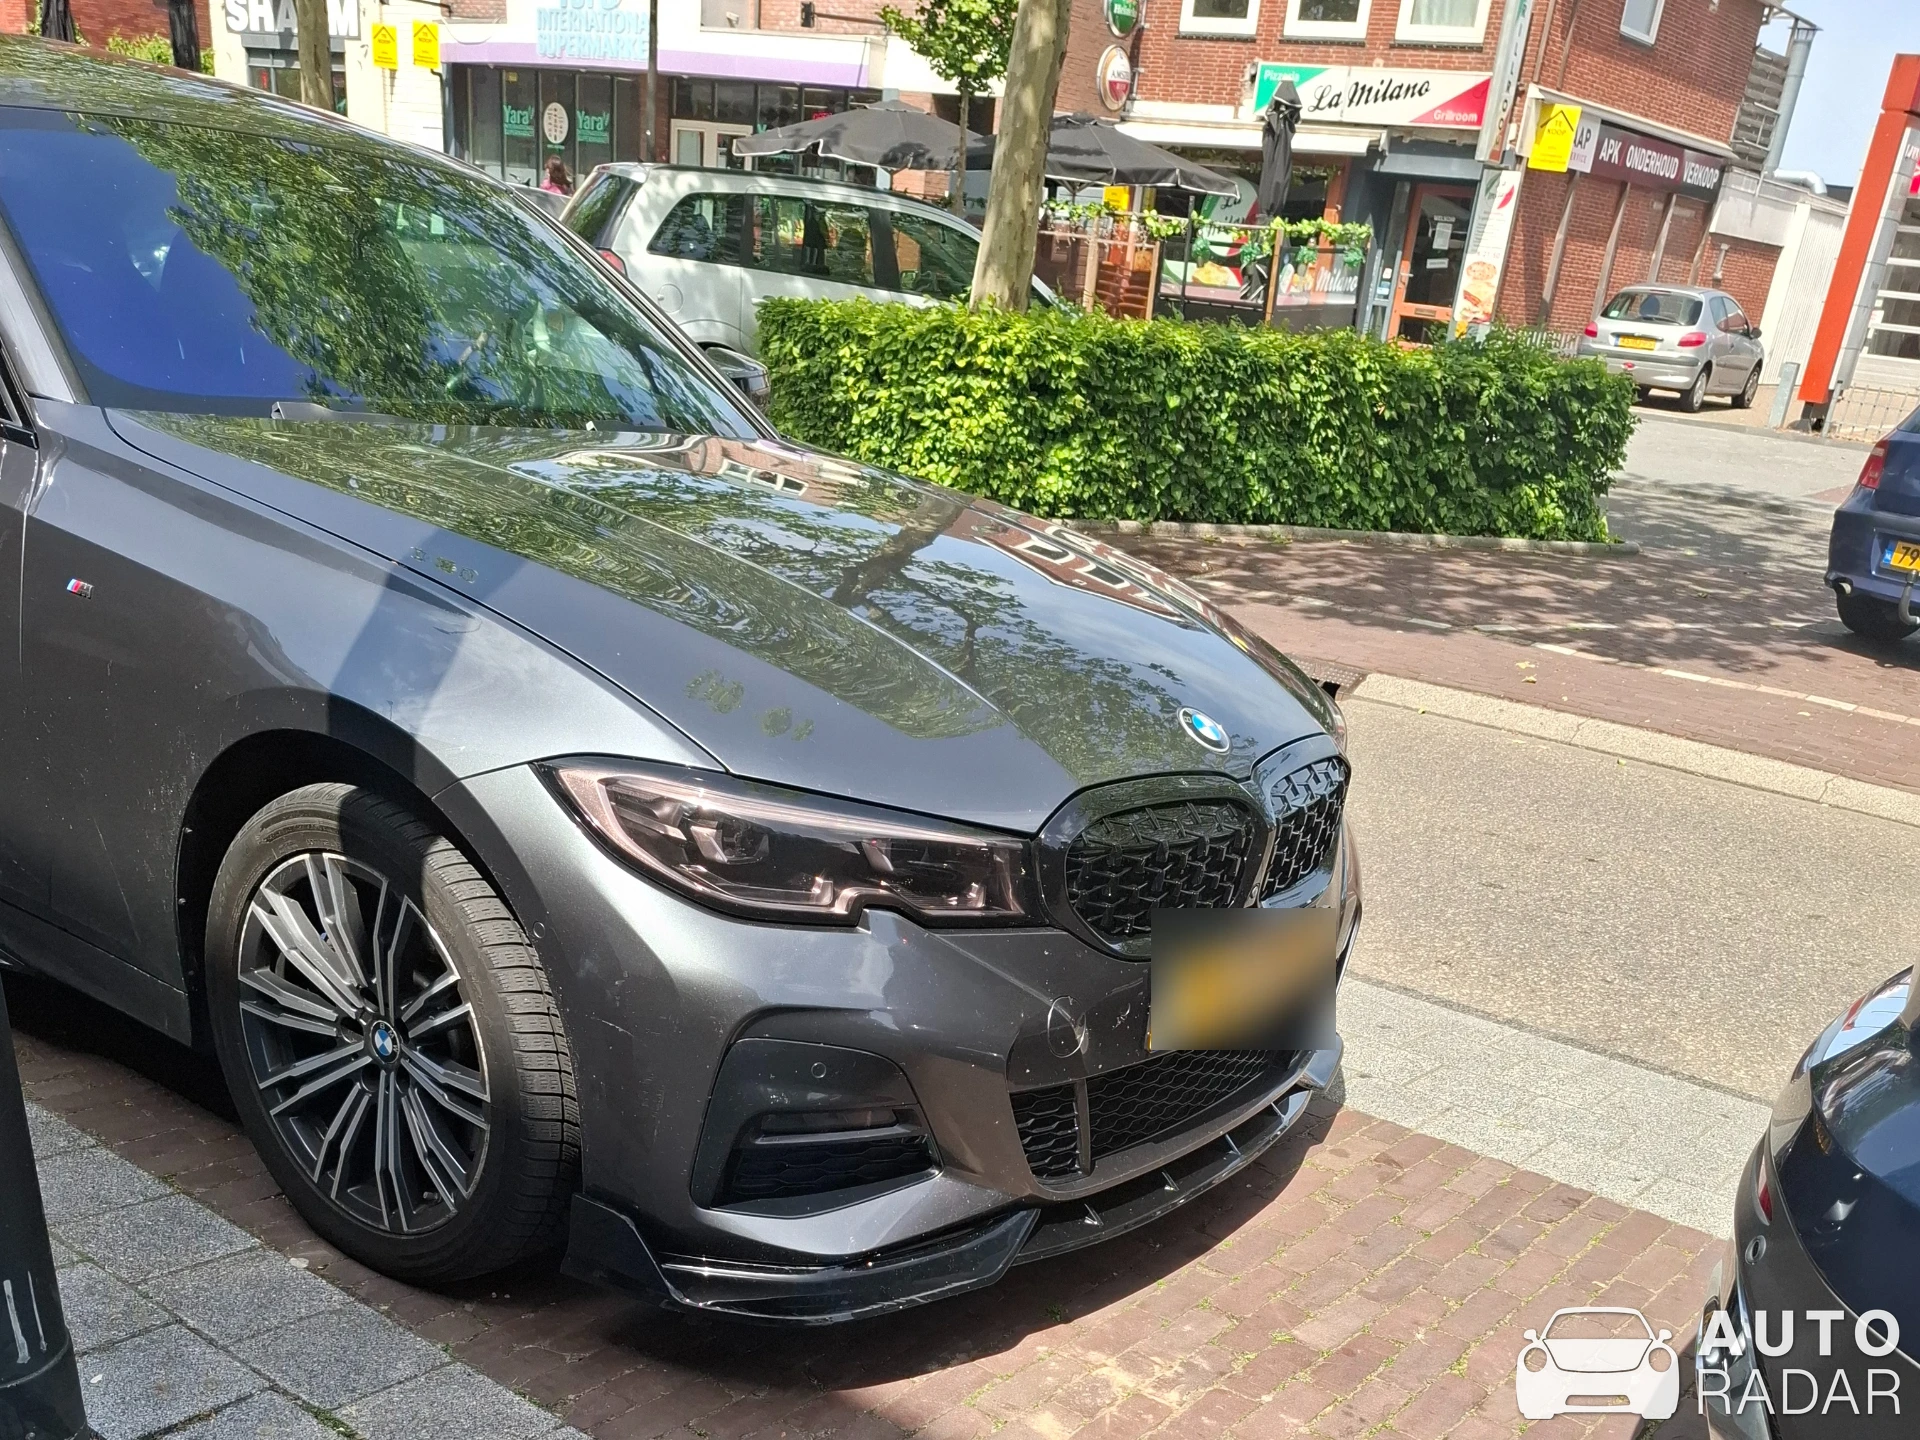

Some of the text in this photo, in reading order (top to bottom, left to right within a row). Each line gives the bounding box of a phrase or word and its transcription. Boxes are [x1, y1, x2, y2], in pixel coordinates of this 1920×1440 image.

[225, 0, 359, 36] SHAM
[537, 8, 650, 34] INTERNATIONA
[537, 34, 650, 61] SUPERMARKE
[1308, 78, 1431, 112] La Milano
[1433, 109, 1477, 122] Grillroom
[1599, 138, 1622, 165] APK
[1625, 144, 1679, 179] ONDERHOUD
[1682, 161, 1720, 190] VERKOOP
[1315, 266, 1358, 292] Milano
